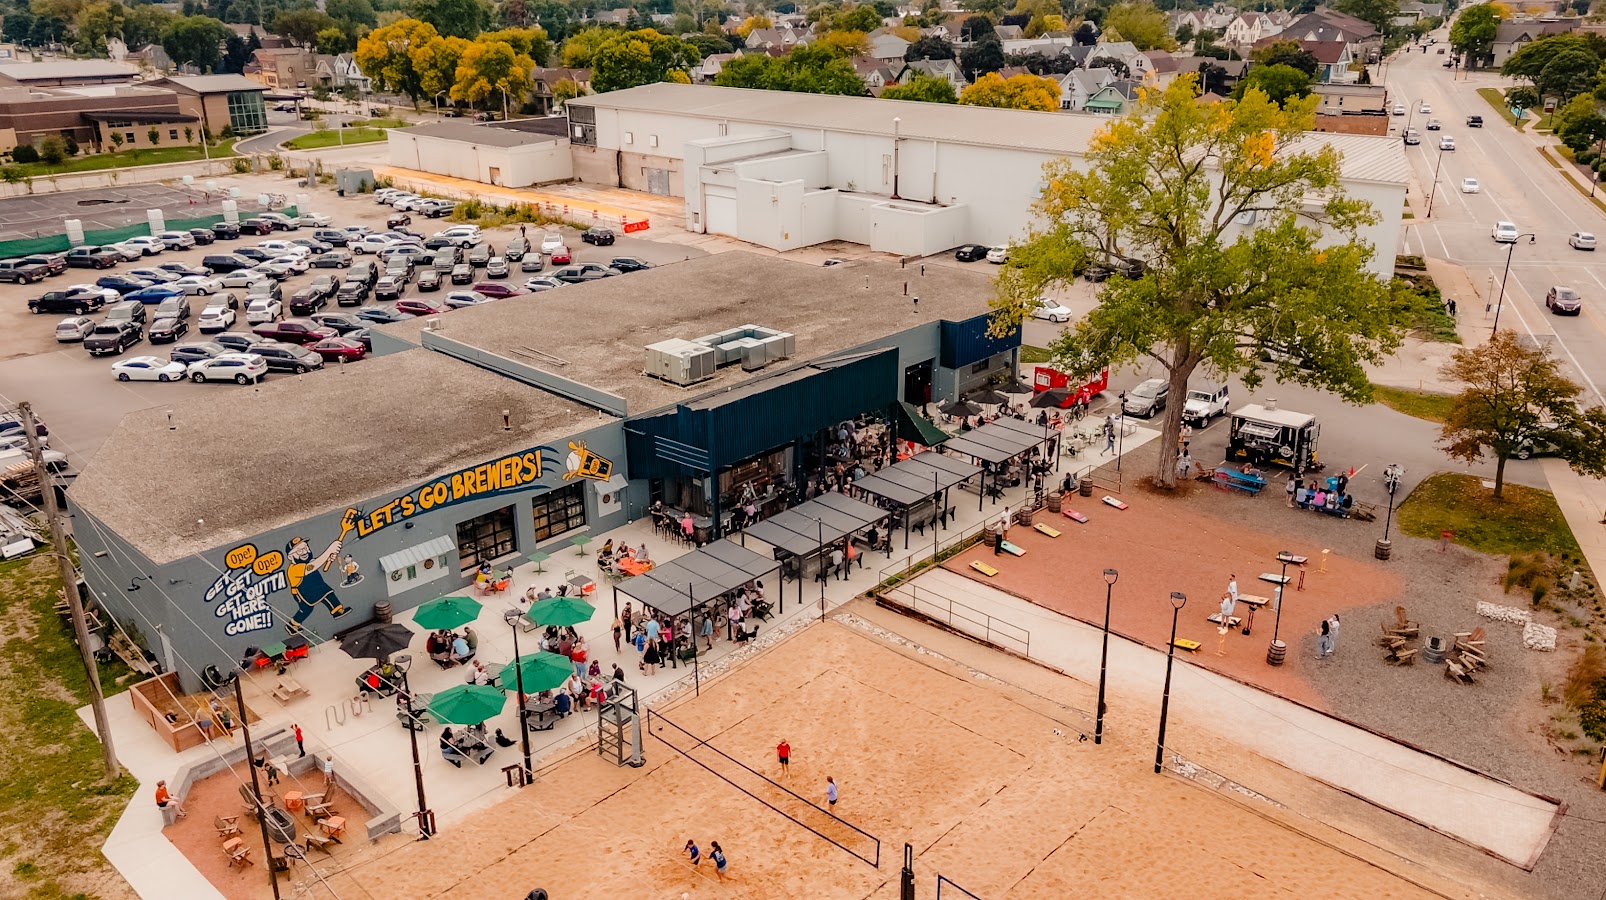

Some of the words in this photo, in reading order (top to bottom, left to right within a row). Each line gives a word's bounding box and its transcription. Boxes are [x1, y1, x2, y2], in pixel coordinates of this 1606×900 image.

[358, 497, 415, 537] LET'S
[418, 482, 447, 510] GO
[451, 450, 542, 499] BREWERS!
[230, 547, 252, 565] Ope!
[257, 554, 278, 571] Ope!
[205, 569, 232, 600] GET
[215, 592, 243, 616] GET
[246, 571, 287, 600] OUTTA
[226, 568, 253, 597] GET
[225, 611, 272, 635] GONE!!
